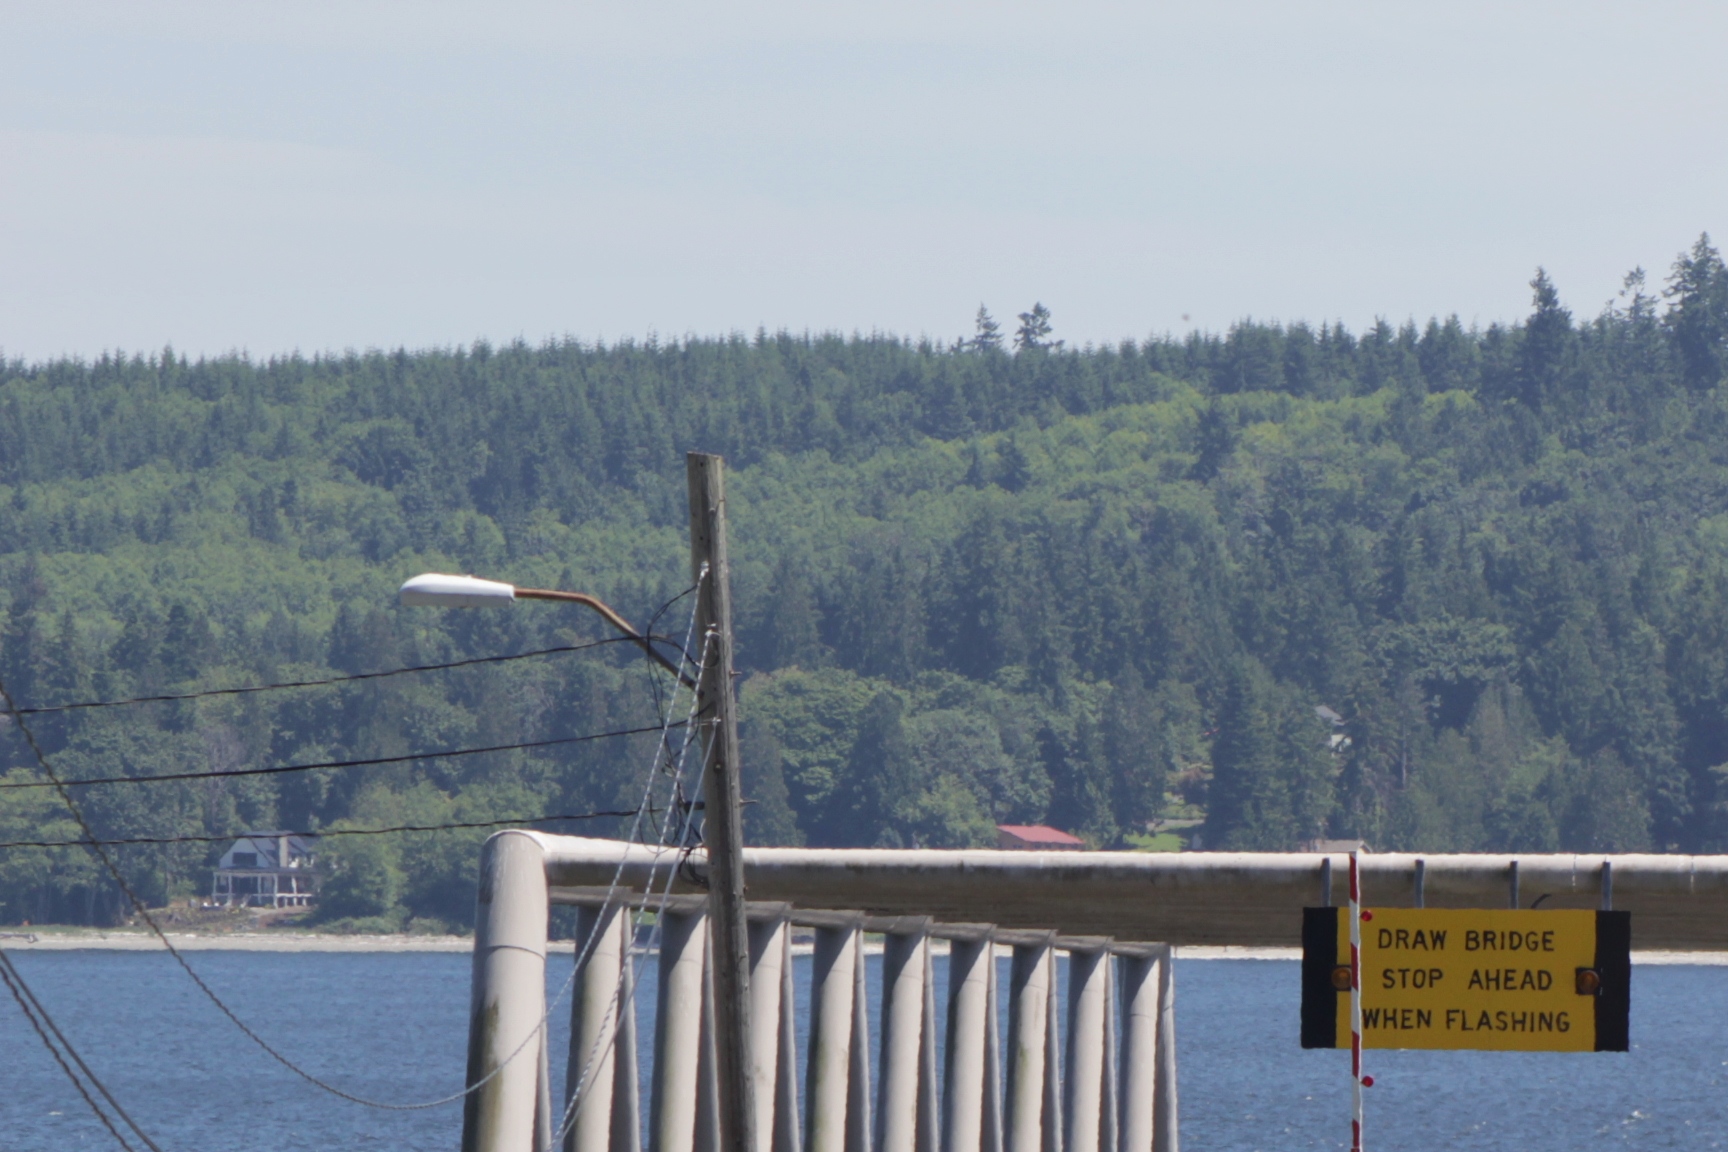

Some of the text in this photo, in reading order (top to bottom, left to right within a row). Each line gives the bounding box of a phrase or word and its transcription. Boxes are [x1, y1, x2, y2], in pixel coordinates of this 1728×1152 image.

[1378, 929, 1555, 952] DRAW BRIDGE
[1382, 968, 1553, 991] STOP AHEAD
[1362, 1008, 1571, 1033] WHEN FLASHING
